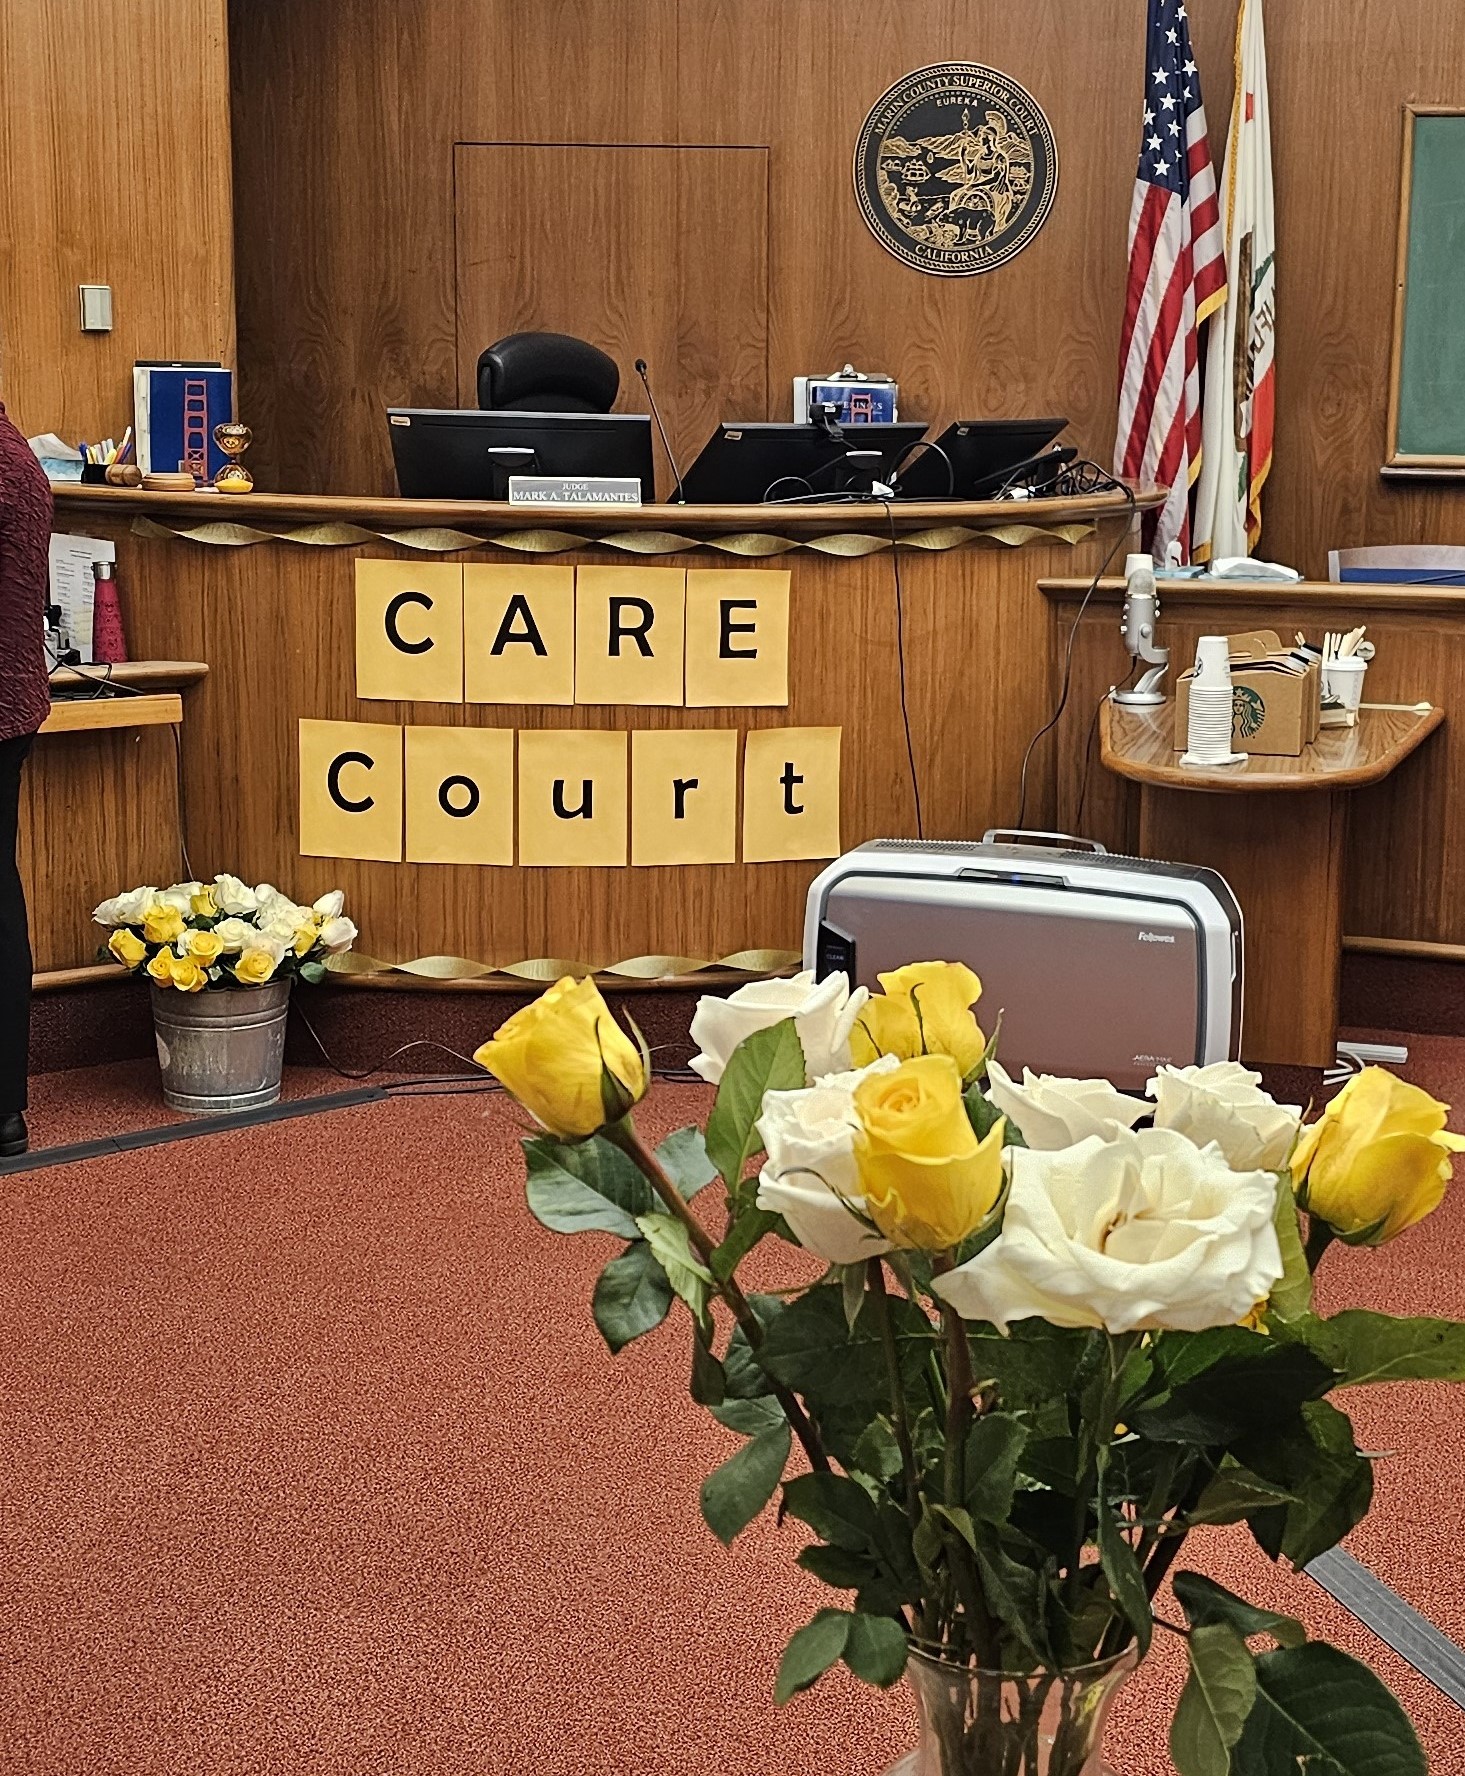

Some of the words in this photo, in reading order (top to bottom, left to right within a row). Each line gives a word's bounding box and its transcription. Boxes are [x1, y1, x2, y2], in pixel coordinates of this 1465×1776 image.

[874, 98, 905, 136] MARIN
[902, 76, 952, 102] COUNTY
[952, 75, 1011, 102] SUPERIOR
[1007, 97, 1040, 137] COURT
[936, 97, 979, 108] EUREKA
[914, 243, 994, 263] CALIFORNIA
[513, 491, 547, 501] MARK
[549, 491, 561, 501] A.
[562, 492, 639, 502] TALAMANTES
[562, 483, 589, 491] JUDGE
[384, 590, 758, 659] CARE
[327, 751, 805, 820] Court
